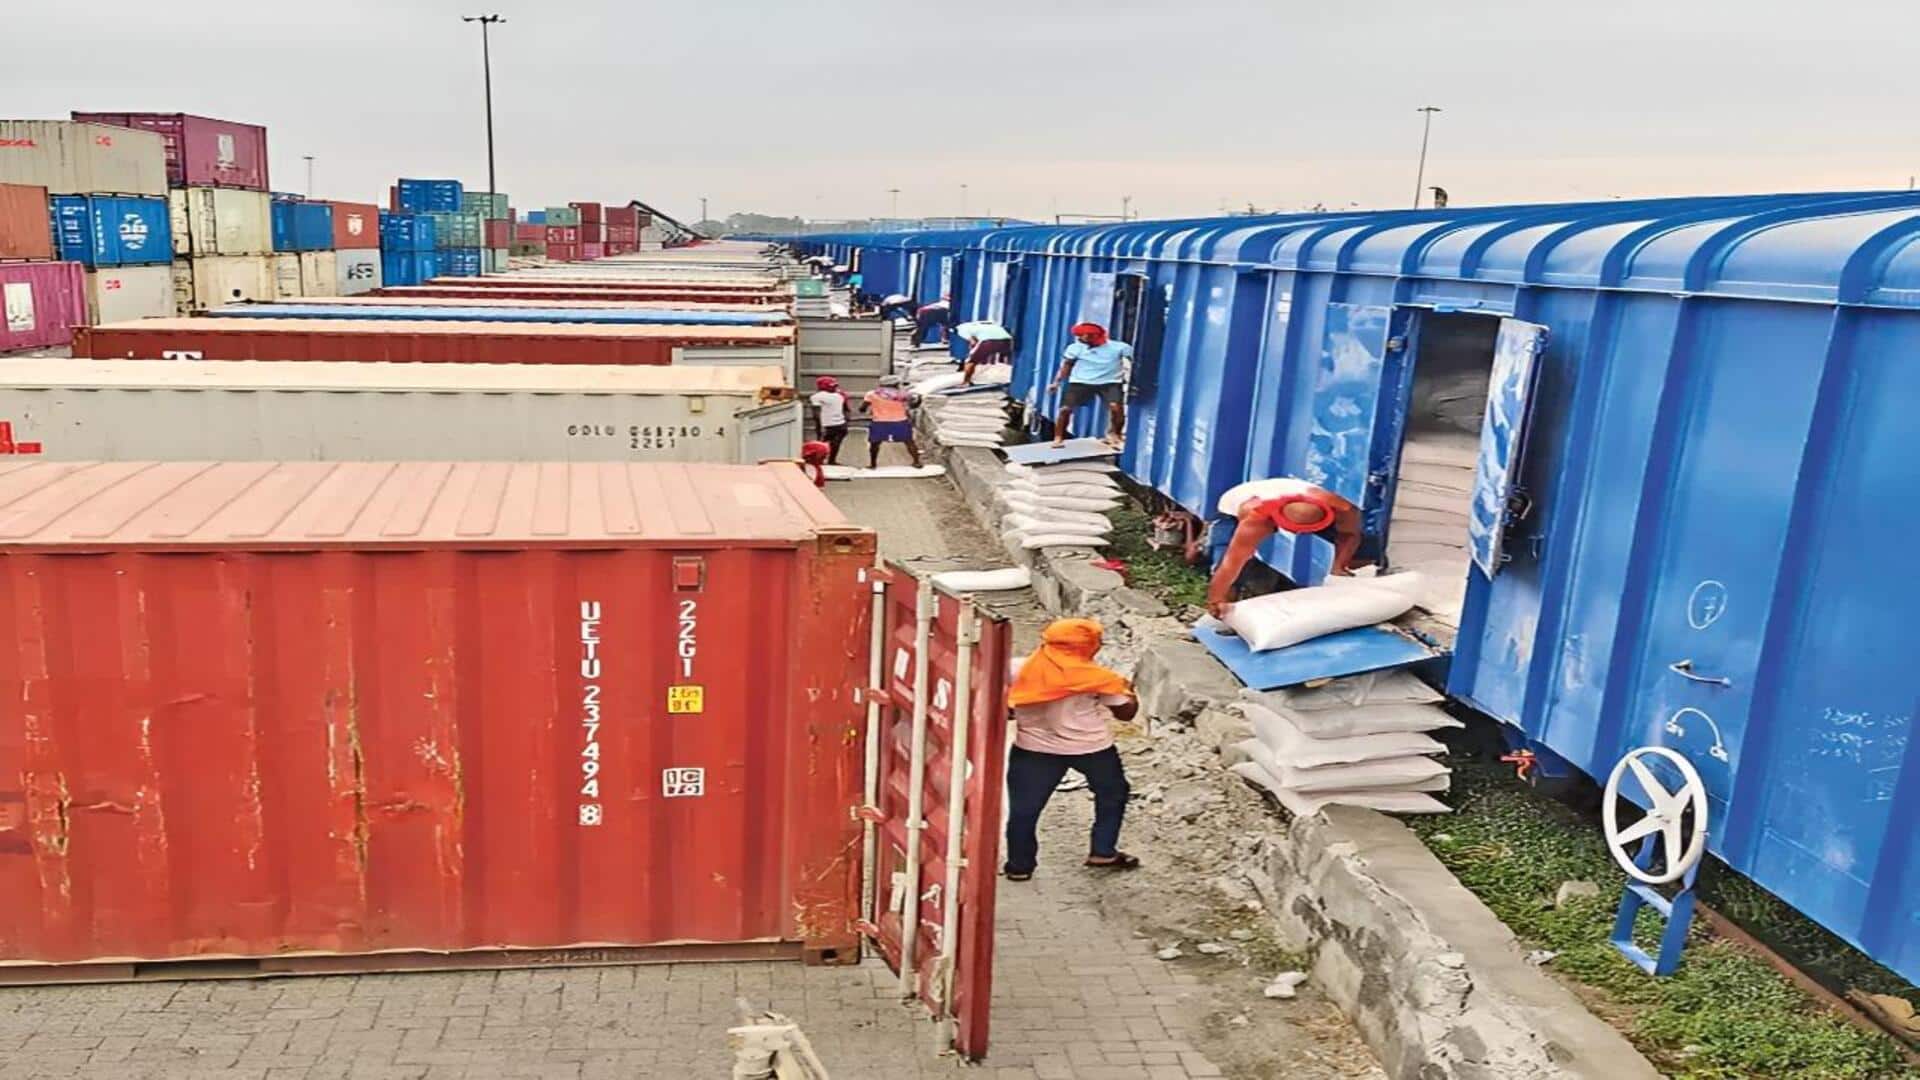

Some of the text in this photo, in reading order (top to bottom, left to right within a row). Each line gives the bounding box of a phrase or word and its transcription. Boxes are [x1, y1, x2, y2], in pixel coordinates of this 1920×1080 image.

[580, 600, 602, 826] UETU 237494 8
[679, 600, 697, 678] 22G1
